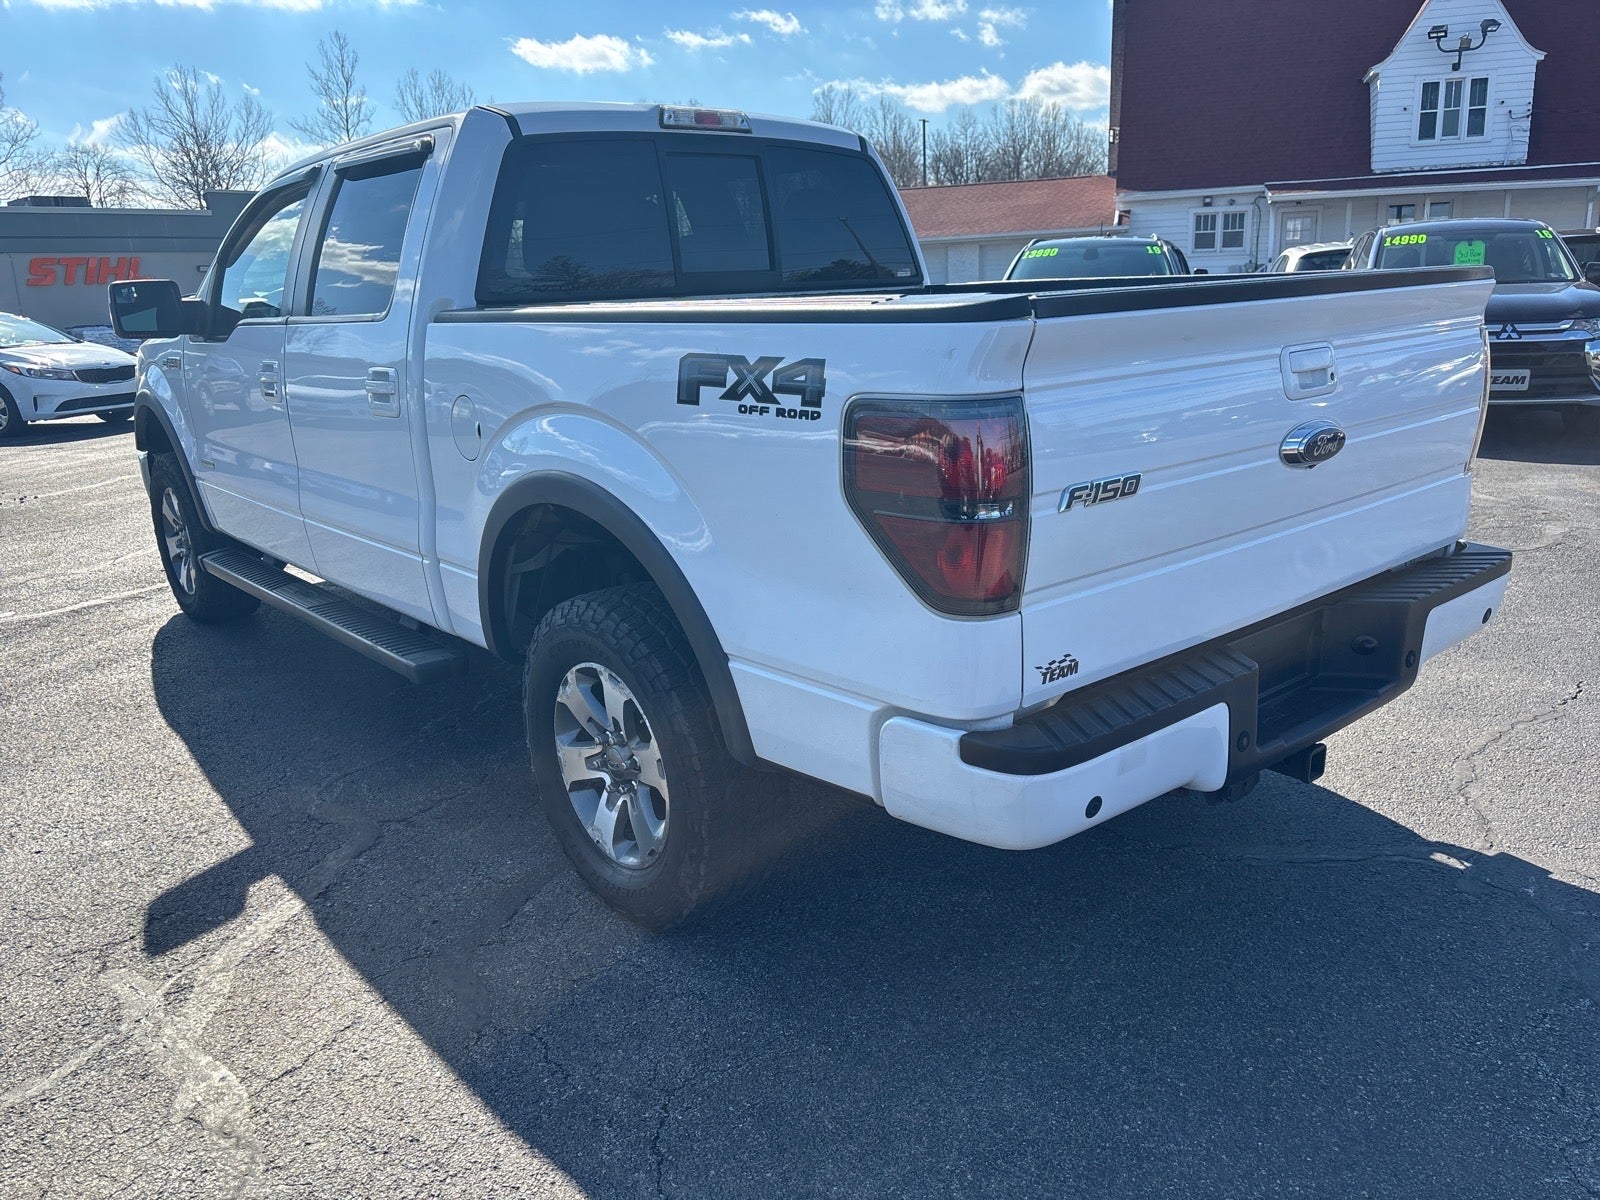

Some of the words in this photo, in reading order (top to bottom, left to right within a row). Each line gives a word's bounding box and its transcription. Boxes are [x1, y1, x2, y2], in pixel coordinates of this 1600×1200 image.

[1384, 234, 1427, 246] 14990
[26, 256, 154, 288] STIHL
[676, 352, 827, 408] FX4
[1490, 375, 1527, 385] EAM
[737, 404, 770, 416] OFF
[775, 407, 822, 421] ROAD
[1313, 433, 1341, 457] Ford
[1039, 660, 1079, 685] TEAM
